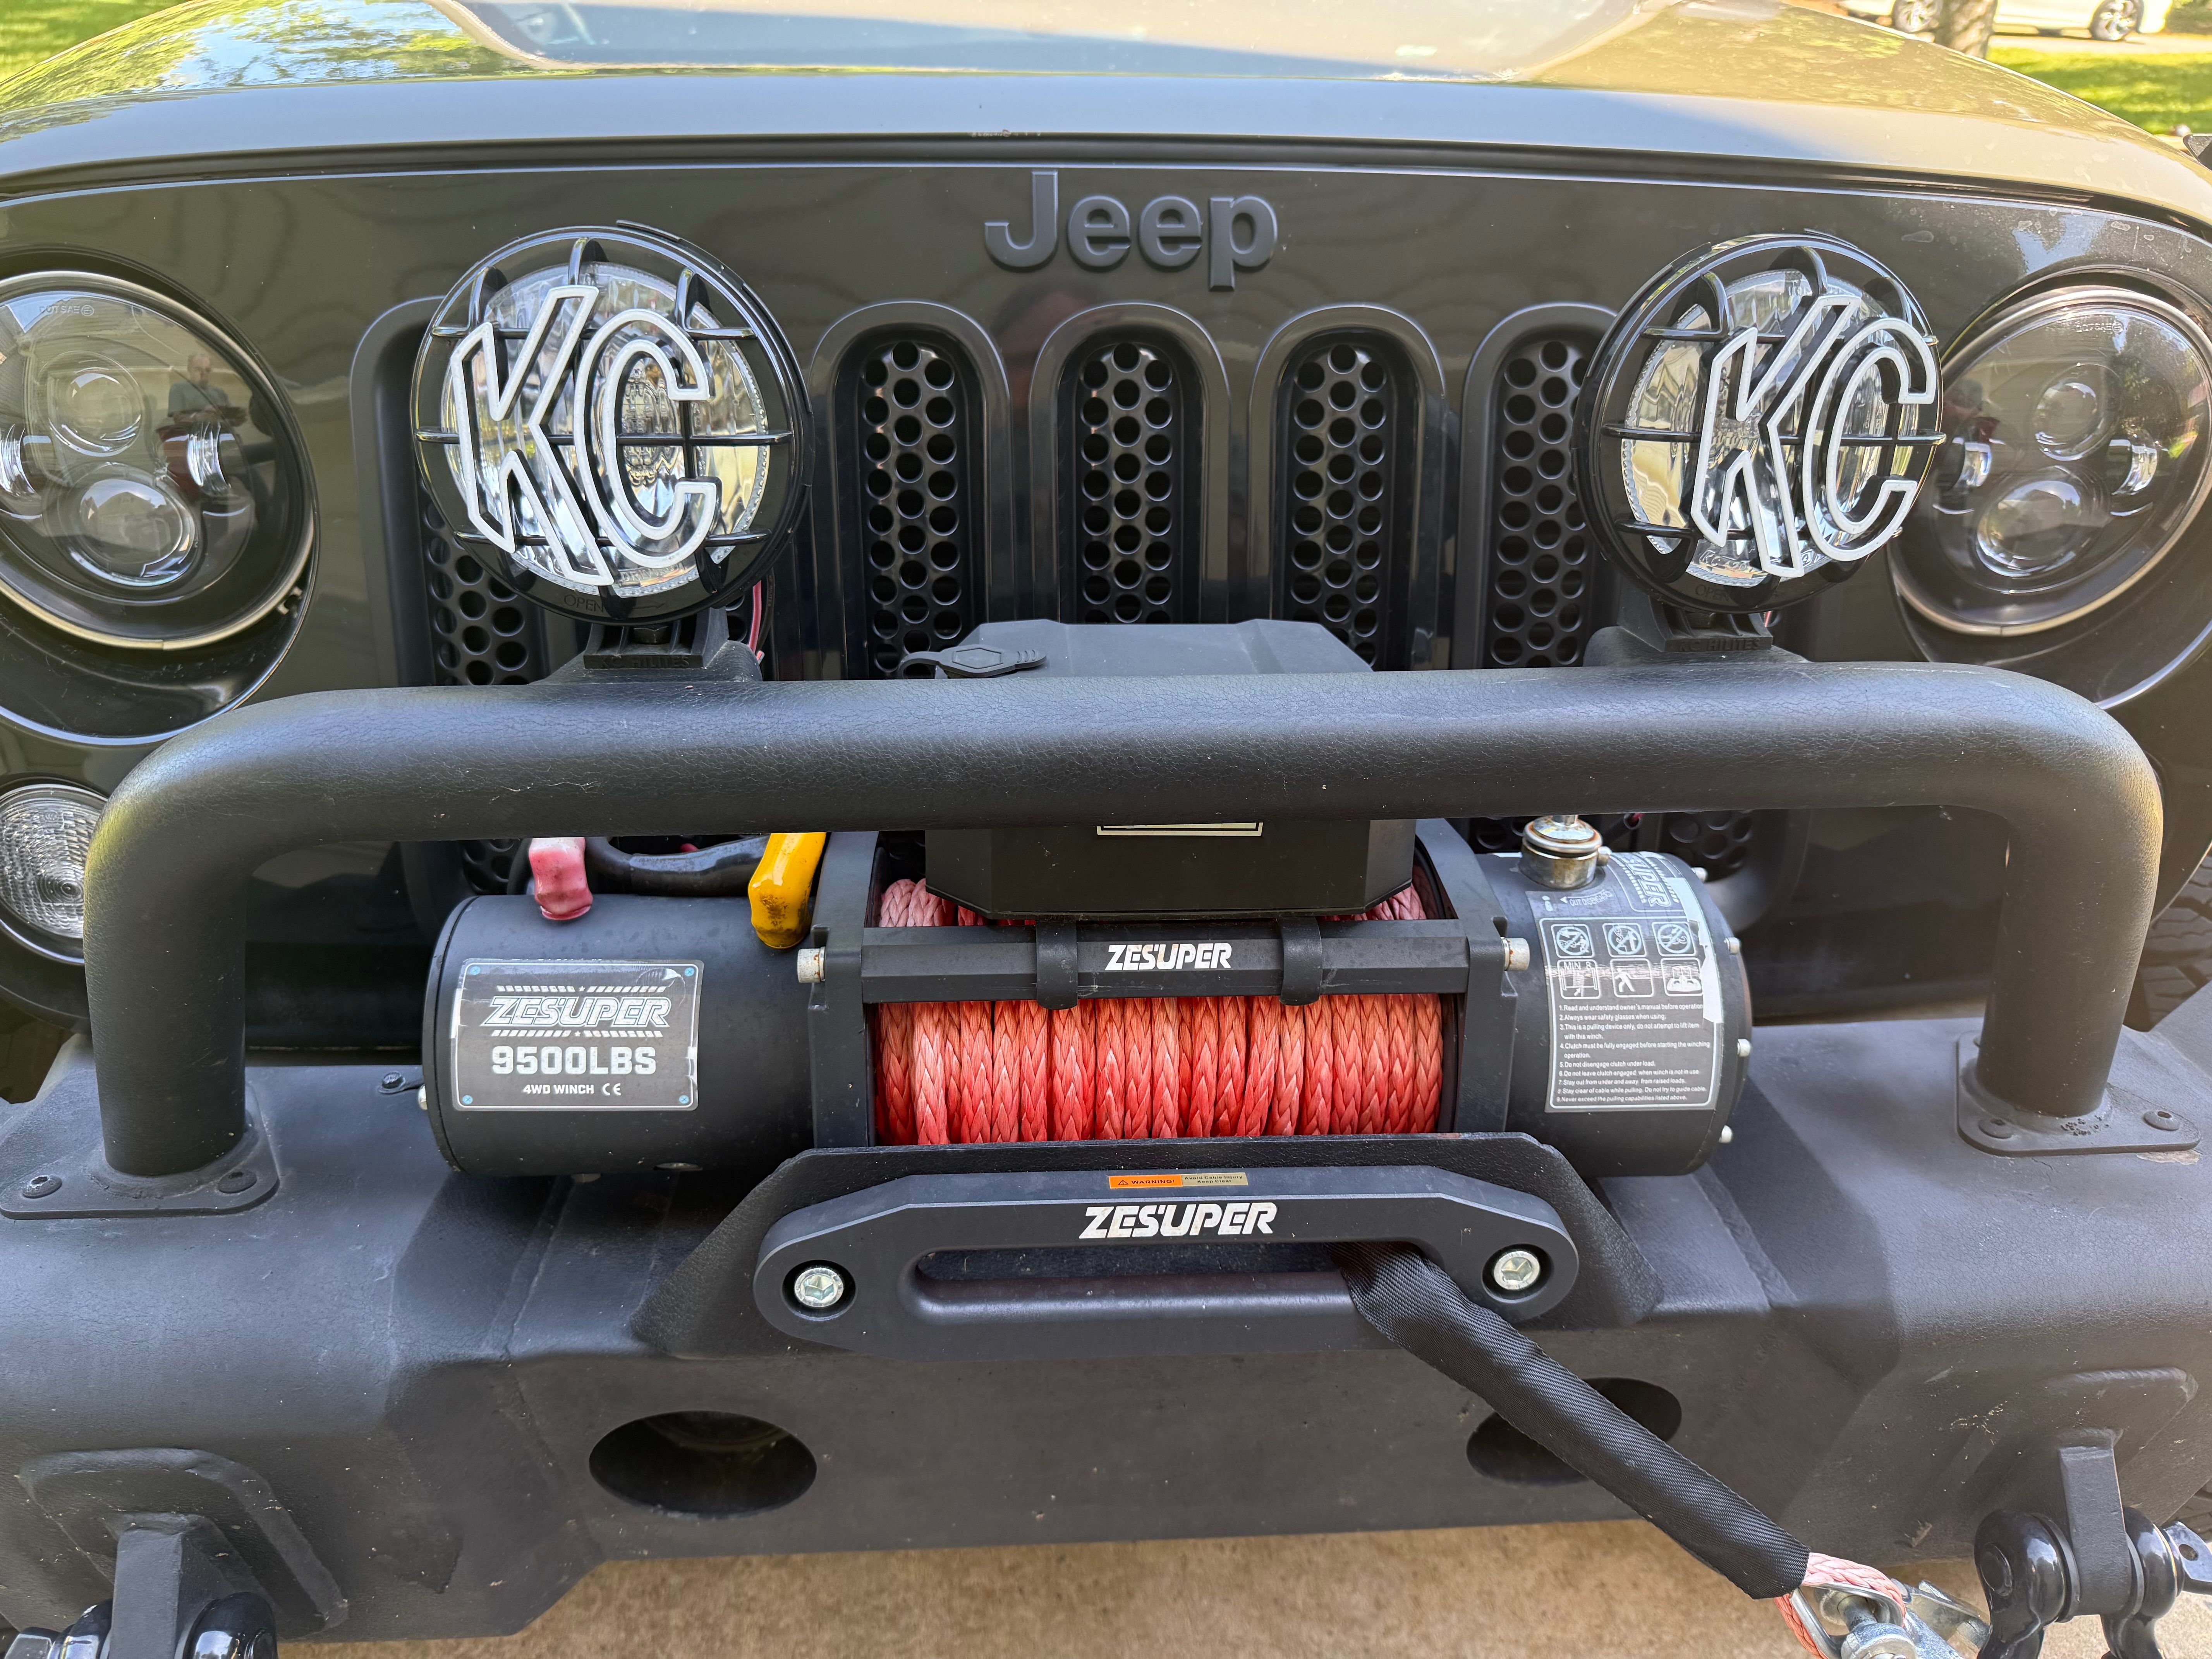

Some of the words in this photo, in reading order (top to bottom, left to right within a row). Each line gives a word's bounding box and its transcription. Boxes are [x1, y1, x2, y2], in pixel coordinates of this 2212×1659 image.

[985, 170, 1278, 292] Jeep
[450, 285, 718, 586] KC
[1690, 295, 1936, 577] KC
[564, 594, 604, 613] OPEN
[1707, 638, 1761, 651] HILITES
[1105, 943, 1232, 970] ZESUPER
[1564, 962, 1581, 970] MIN
[480, 996, 672, 1027] ZESUPER
[491, 1046, 656, 1075] 9500LBS
[523, 1084, 551, 1095] 4WD
[553, 1084, 594, 1095] WINCH
[1079, 1202, 1277, 1239] ZESUPER
